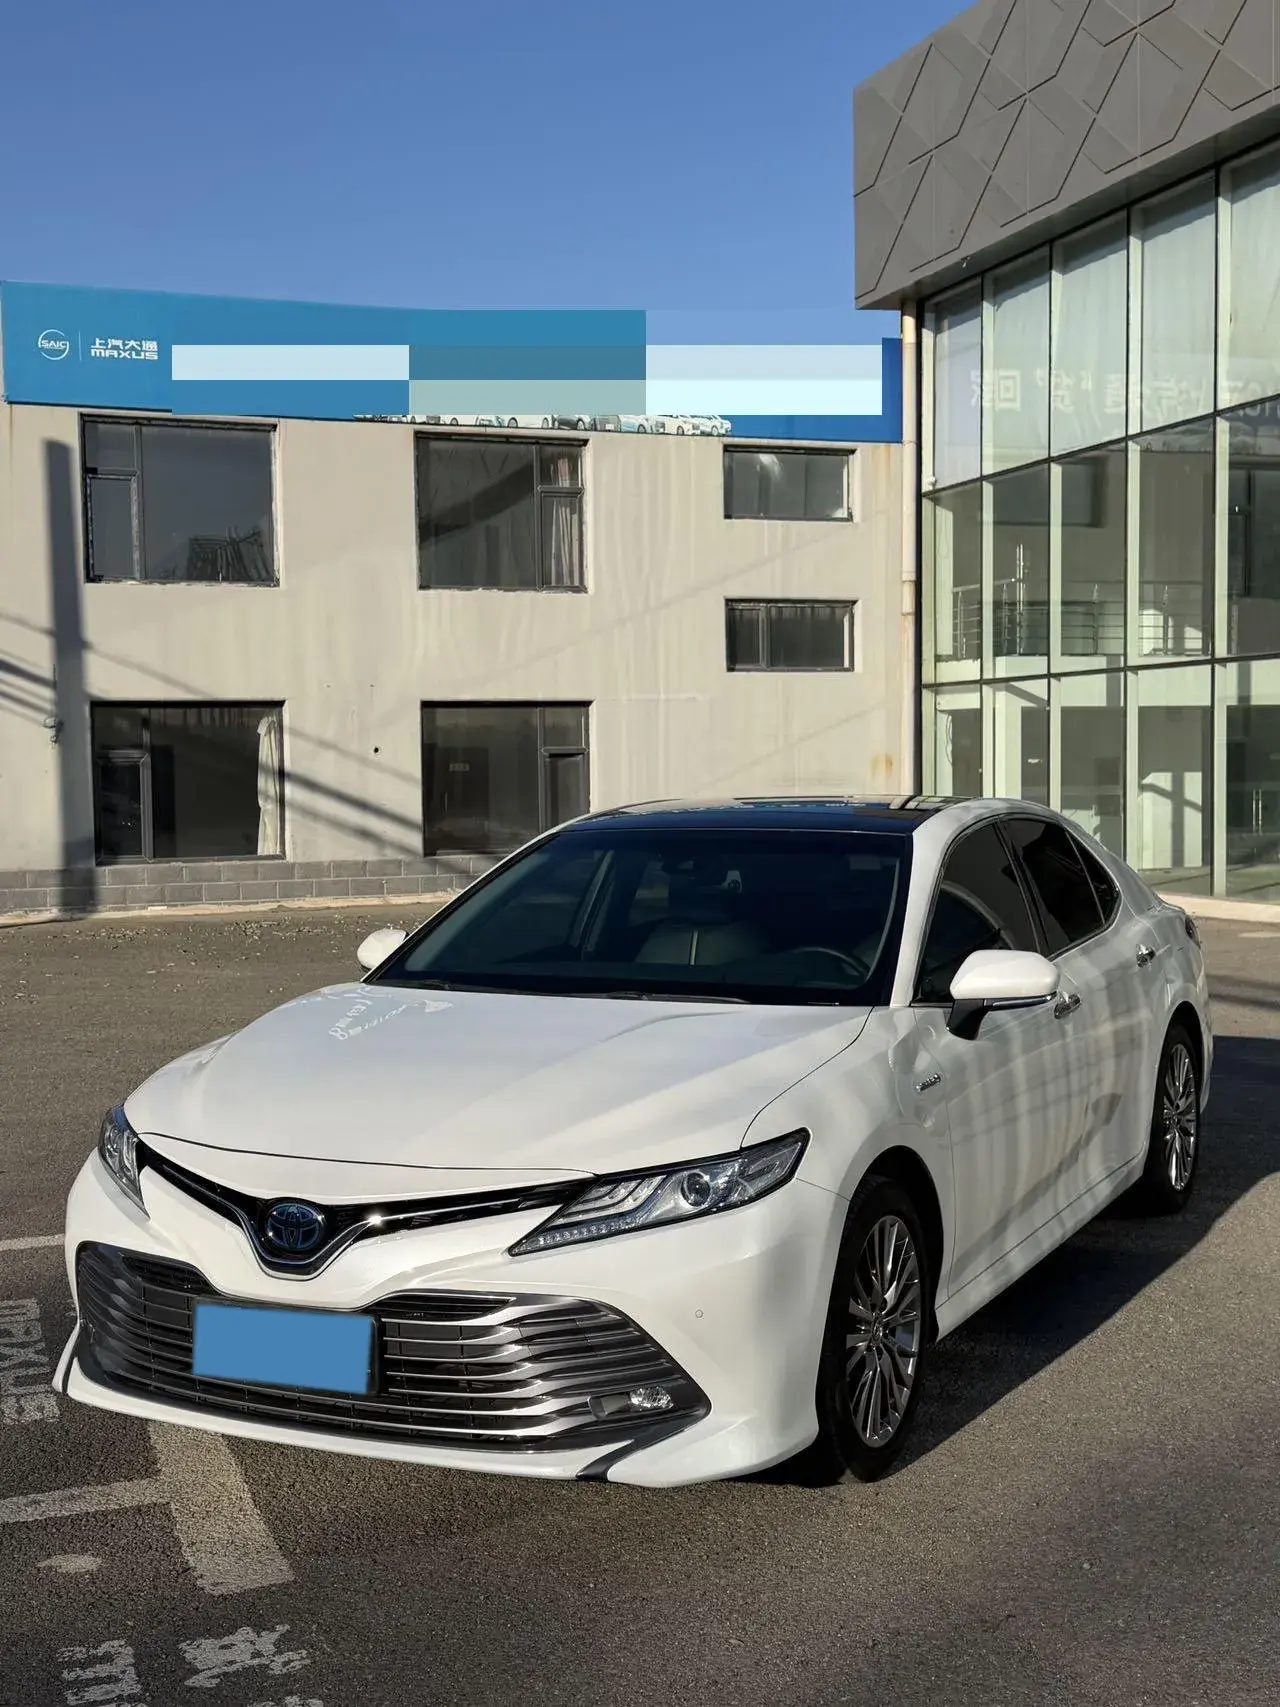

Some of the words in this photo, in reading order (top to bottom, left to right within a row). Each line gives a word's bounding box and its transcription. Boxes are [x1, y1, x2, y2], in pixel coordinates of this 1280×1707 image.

[90, 337, 159, 352] 上汽大通
[90, 348, 159, 360] MAXUS
